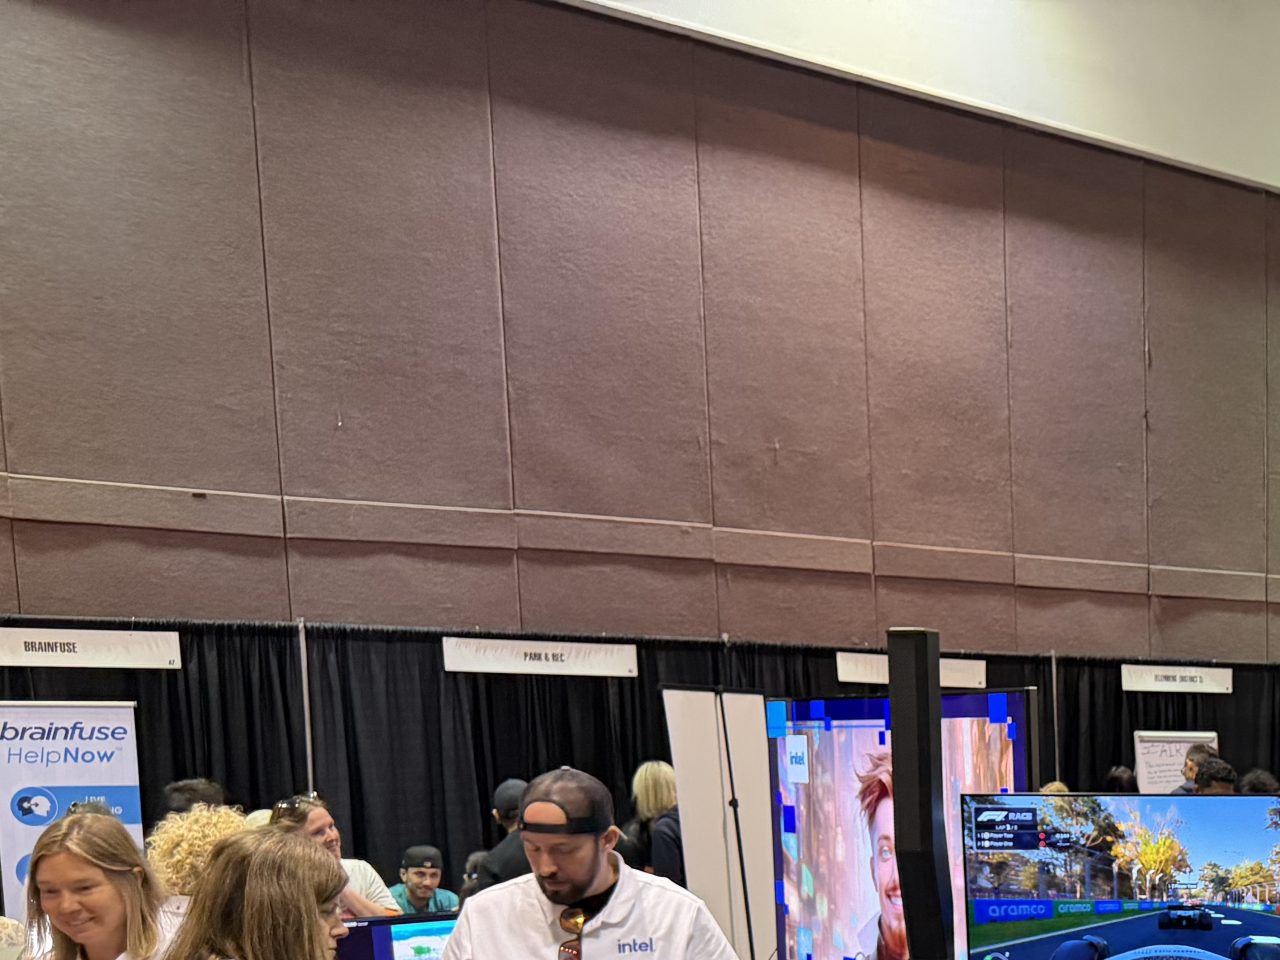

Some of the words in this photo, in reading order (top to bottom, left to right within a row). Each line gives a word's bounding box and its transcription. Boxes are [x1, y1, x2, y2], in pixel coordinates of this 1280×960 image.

[24, 641, 78, 653] BRAINFUSE
[0, 722, 128, 741] brainfuse
[988, 905, 1046, 917] aramco
[1058, 903, 1091, 912] aramco
